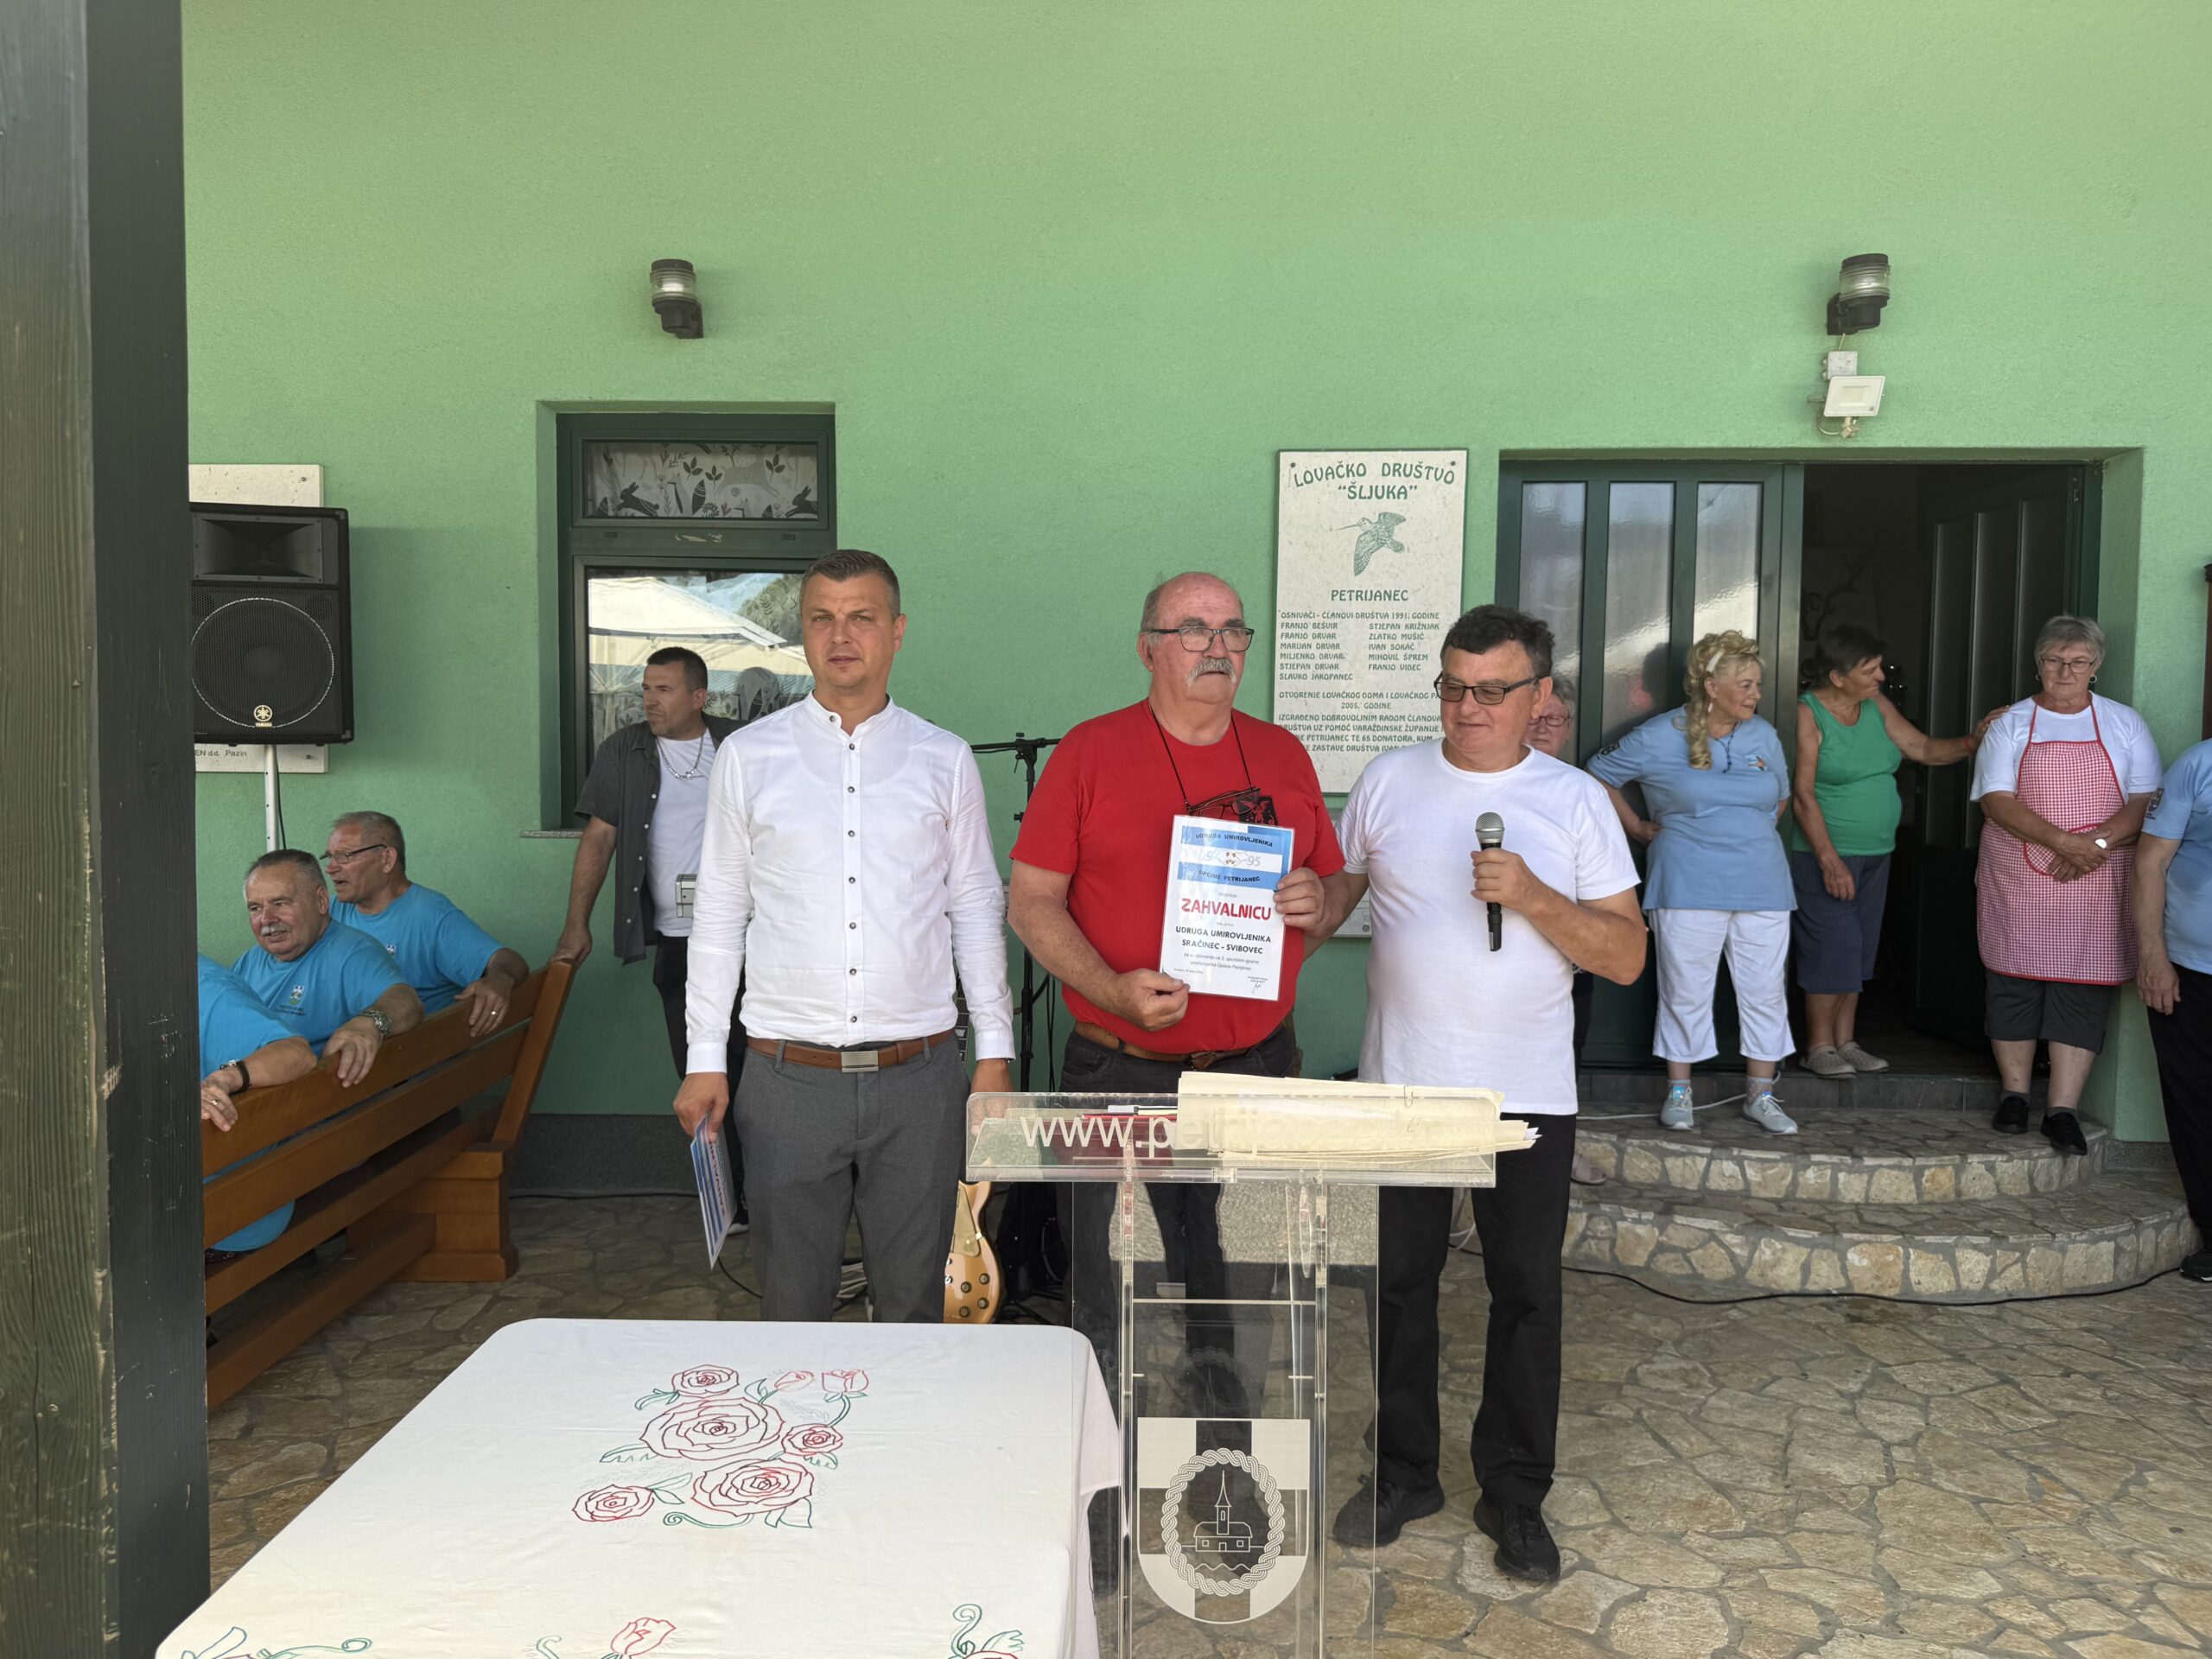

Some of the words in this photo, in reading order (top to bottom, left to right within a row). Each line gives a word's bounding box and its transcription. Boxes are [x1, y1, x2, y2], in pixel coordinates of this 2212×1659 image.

[1294, 461, 1367, 487] LOVAČKO
[1382, 461, 1455, 485] DRUŠTVO
[1331, 589, 1409, 601] PETRIJANEC
[1355, 611, 1389, 620] DRUŠTVA
[1322, 690, 1361, 699] LOVAČKOG
[1390, 690, 1429, 699] LOVAČKOG
[1352, 723, 1403, 732] VARAŽDINSKE
[1405, 724, 1440, 733] ŽUPANIJE
[1224, 834, 1273, 847] UMIROVLJENIKA
[1181, 898, 1272, 921] ZAHVALNICU
[1175, 925, 1209, 937] UDRUGA
[1211, 930, 1271, 943] UMIROVLJENIKA
[1226, 944, 1263, 955] SVIBOVEC
